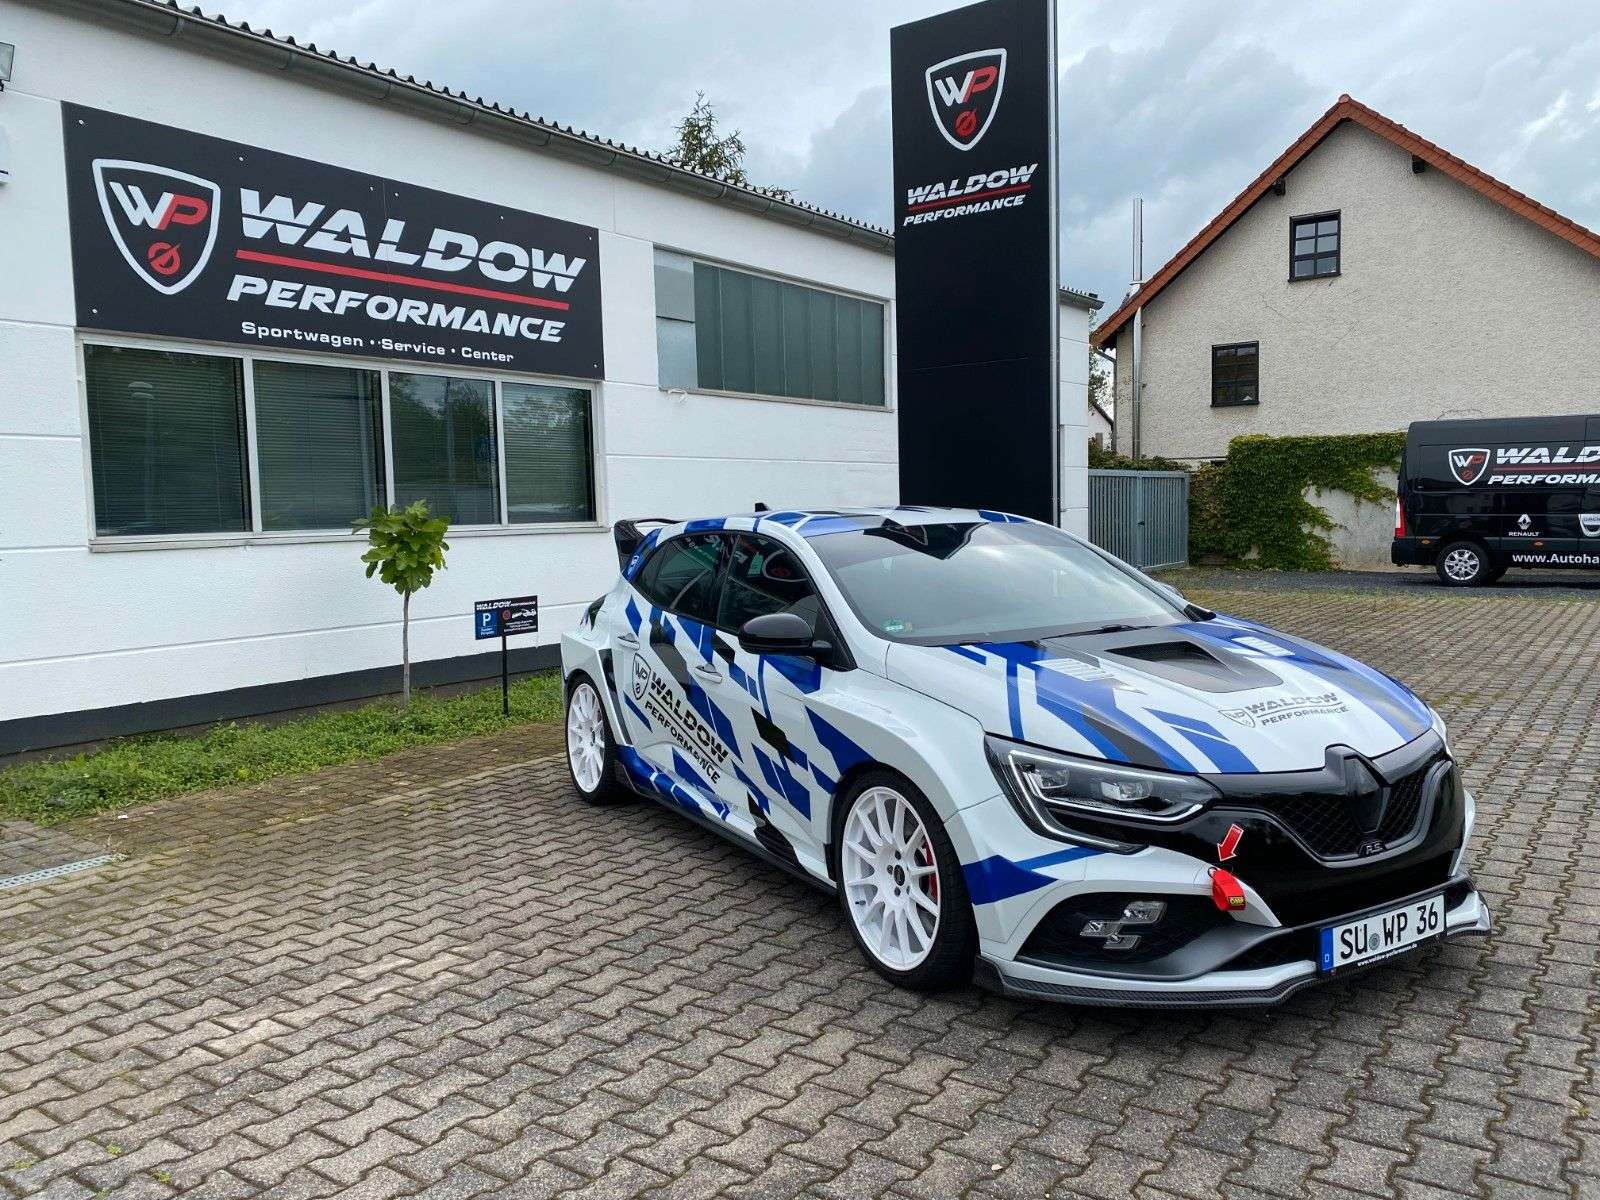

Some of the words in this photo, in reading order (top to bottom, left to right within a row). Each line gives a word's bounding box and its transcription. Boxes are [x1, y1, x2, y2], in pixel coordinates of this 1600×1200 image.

[935, 65, 998, 107] WP
[907, 163, 1039, 205] WALDOW
[109, 181, 209, 230] WP
[903, 194, 1026, 227] PERFORMANCE
[240, 187, 587, 293] WALDOW
[226, 274, 566, 343] PERFORMANCE
[241, 321, 363, 348] Sportwagen
[382, 338, 446, 356] Service
[461, 346, 514, 363] Center
[1512, 553, 1600, 564] www.Autoha
[482, 613, 491, 626] P
[651, 671, 729, 763] WALDOW
[1245, 692, 1339, 714] WALDOW
[1262, 706, 1349, 726] PERFORMANCE
[645, 701, 721, 784] PERFORMANCE
[1340, 924, 1367, 960] SU
[1383, 912, 1408, 946] WP
[1416, 902, 1438, 935] 36
